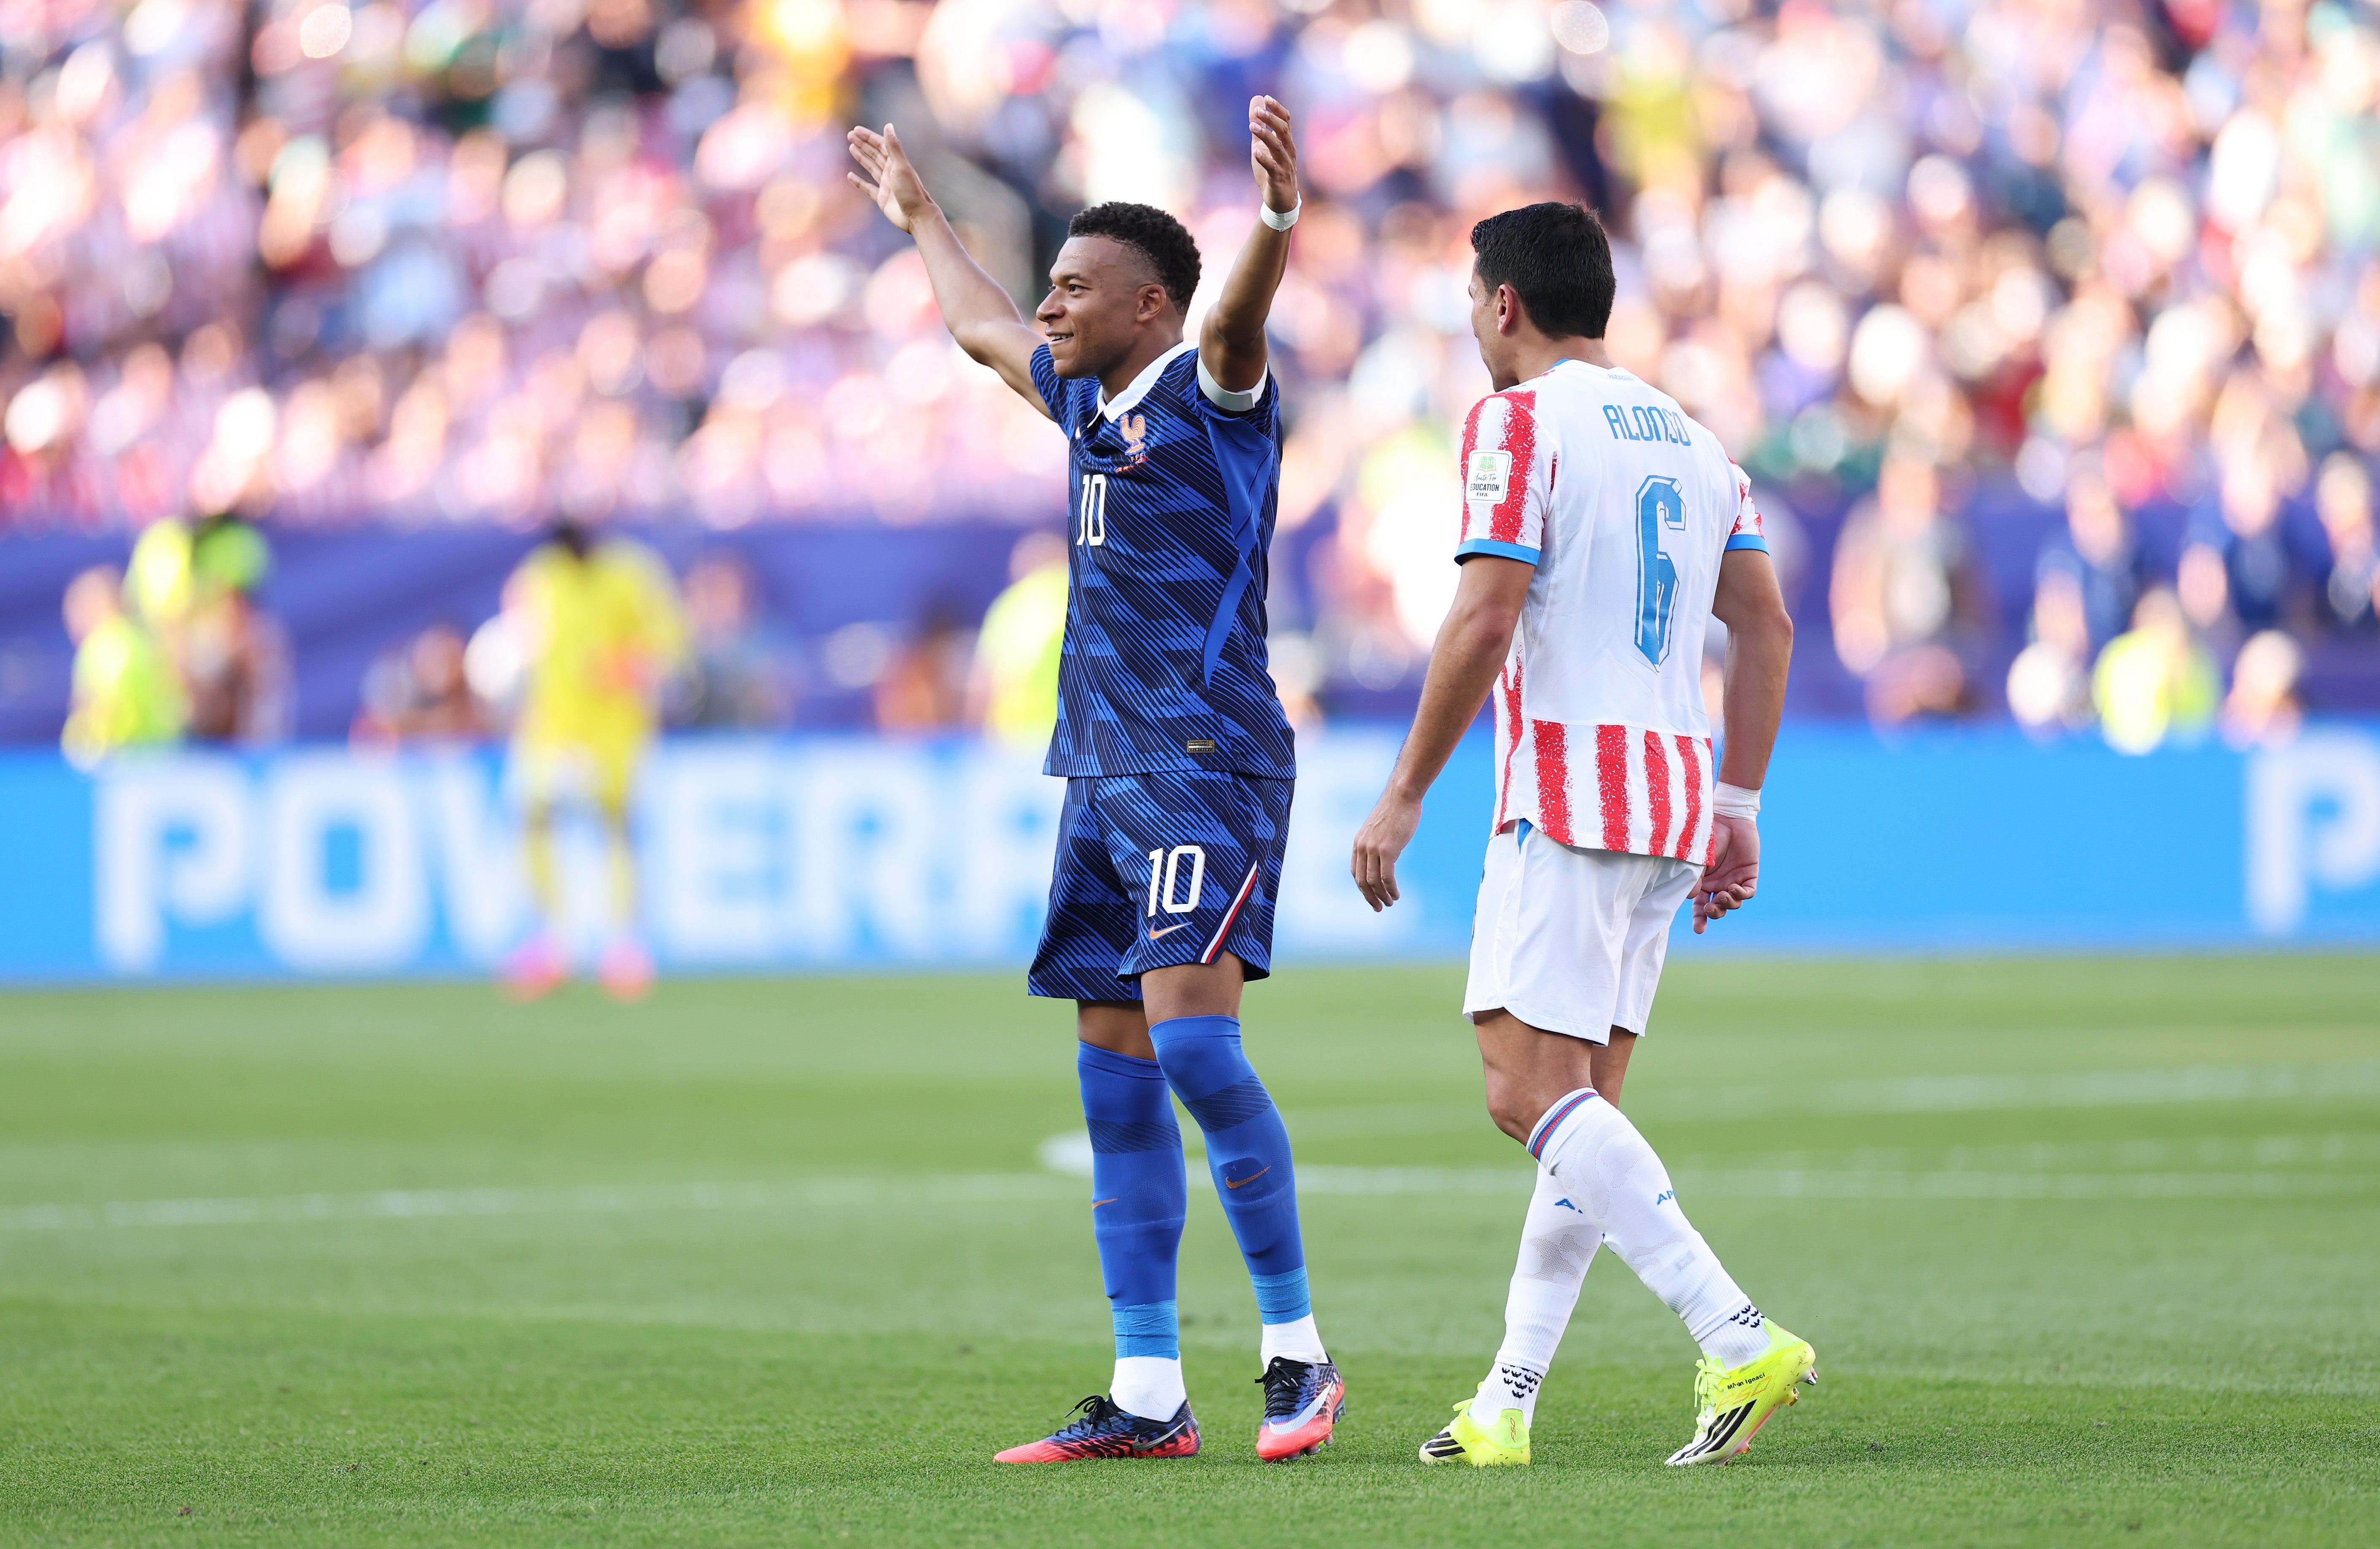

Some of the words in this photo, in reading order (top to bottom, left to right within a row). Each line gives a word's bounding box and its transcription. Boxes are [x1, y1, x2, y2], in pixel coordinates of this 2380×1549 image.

[1603, 405, 1691, 446] ALONSO
[1077, 474, 1107, 546] 10
[1474, 473, 1488, 482] Unite
[1634, 475, 1686, 673] 6
[91, 728, 1422, 973] POWERAE
[1148, 845, 1206, 917] 10
[1657, 1190, 1677, 1205] AP
